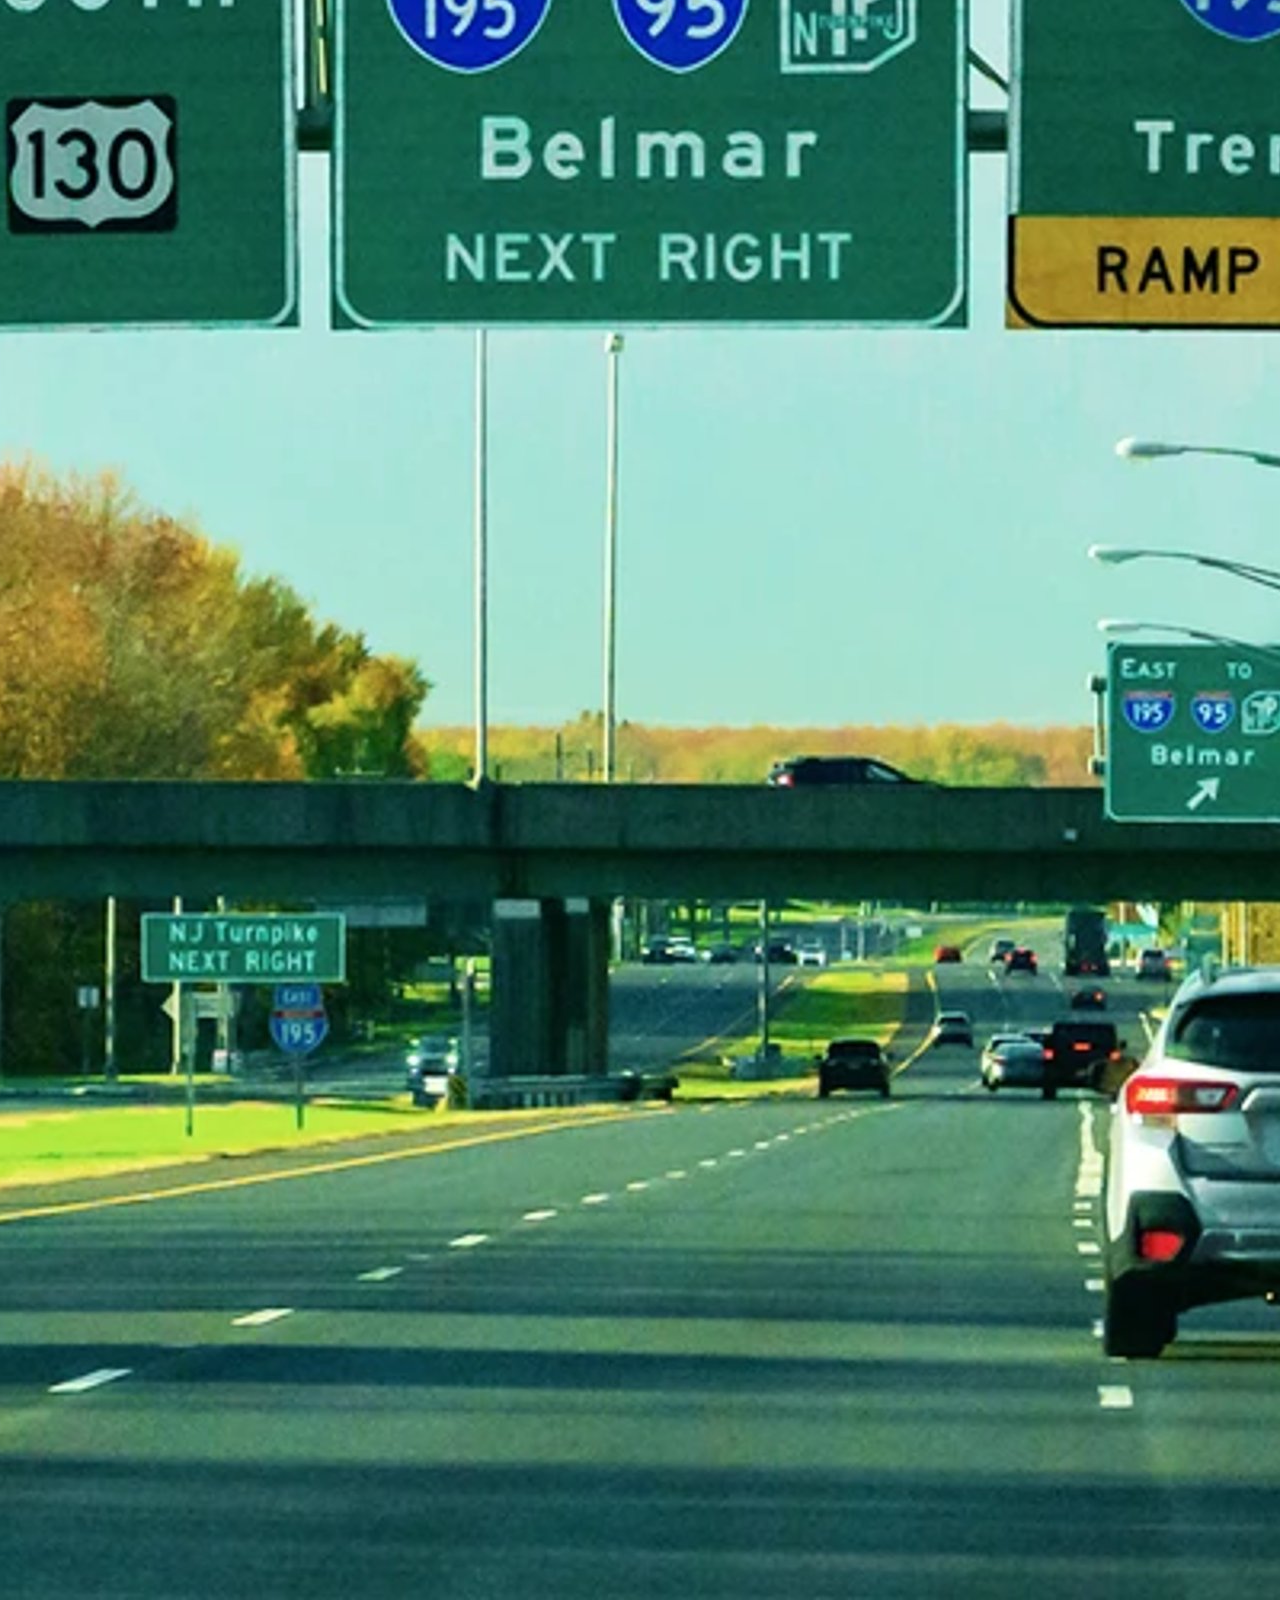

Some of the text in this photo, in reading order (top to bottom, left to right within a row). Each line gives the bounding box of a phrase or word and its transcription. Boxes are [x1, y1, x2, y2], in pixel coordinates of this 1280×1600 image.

[480, 115, 817, 180] Belmar
[26, 127, 157, 201] 130
[445, 232, 853, 283] NEXT RIGHT
[1097, 245, 1261, 294] RAMP
[1121, 658, 1253, 680] EAST TO
[1132, 702, 1165, 724] 195
[1198, 702, 1228, 725] 95
[1150, 743, 1256, 766] Belmar
[170, 921, 320, 948] NJ Turnpike
[170, 951, 318, 972] NEXT RIGHT
[281, 1023, 316, 1045] 195
